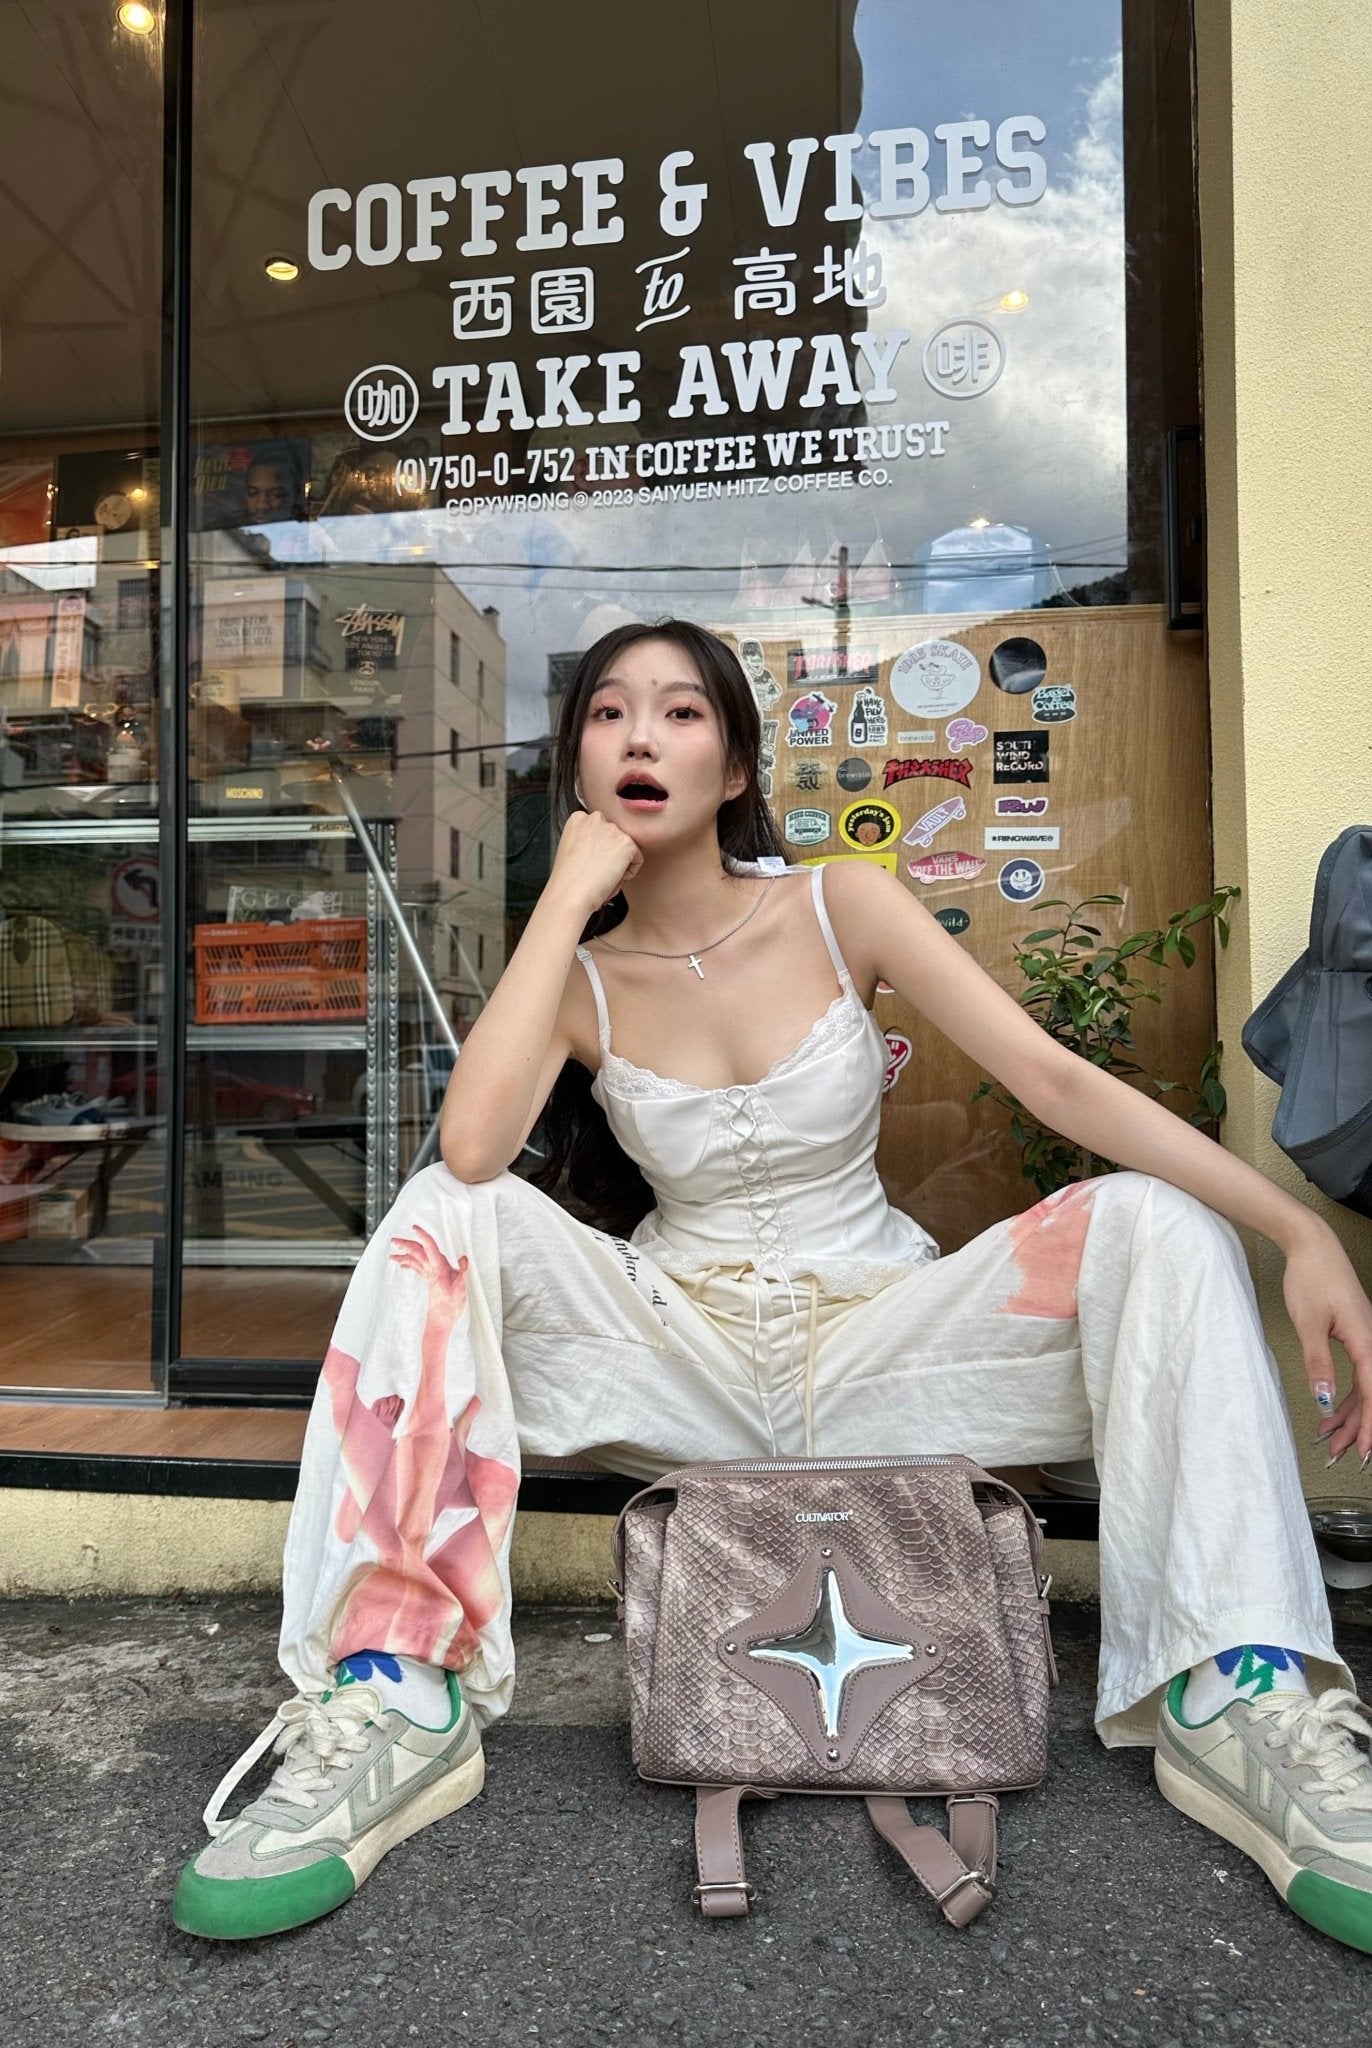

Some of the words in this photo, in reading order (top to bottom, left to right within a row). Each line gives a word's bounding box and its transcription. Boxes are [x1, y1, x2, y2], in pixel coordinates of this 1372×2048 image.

[308, 158, 624, 271] COFFEE
[659, 150, 708, 237] &
[743, 115, 1047, 227] VIBES
[449, 267, 595, 340] 西園
[640, 257, 688, 322] to
[732, 240, 888, 319] 高地
[353, 376, 409, 432] 咖
[432, 350, 641, 436] TAKE
[668, 328, 911, 418] AWAY
[931, 326, 995, 389] 啡
[395, 447, 575, 497] (0)750-0-752
[585, 445, 630, 481] IN
[636, 434, 757, 478] COFFEE
[763, 430, 823, 468] WE
[828, 421, 950, 463] TRUST
[446, 492, 569, 516] COPYWRONG
[592, 488, 634, 507] 2023
[638, 480, 722, 504] SAIYUEN
[726, 476, 770, 498] HITZ
[774, 469, 854, 493] COFFEE
[858, 468, 893, 487] CO.
[930, 644, 973, 671] SKATE
[789, 729, 829, 738] UNITED
[789, 737, 829, 746] POWER
[883, 758, 974, 790] THRASHER
[917, 806, 950, 831] VAULT
[931, 854, 959, 864] VANS
[934, 863, 954, 876] THE
